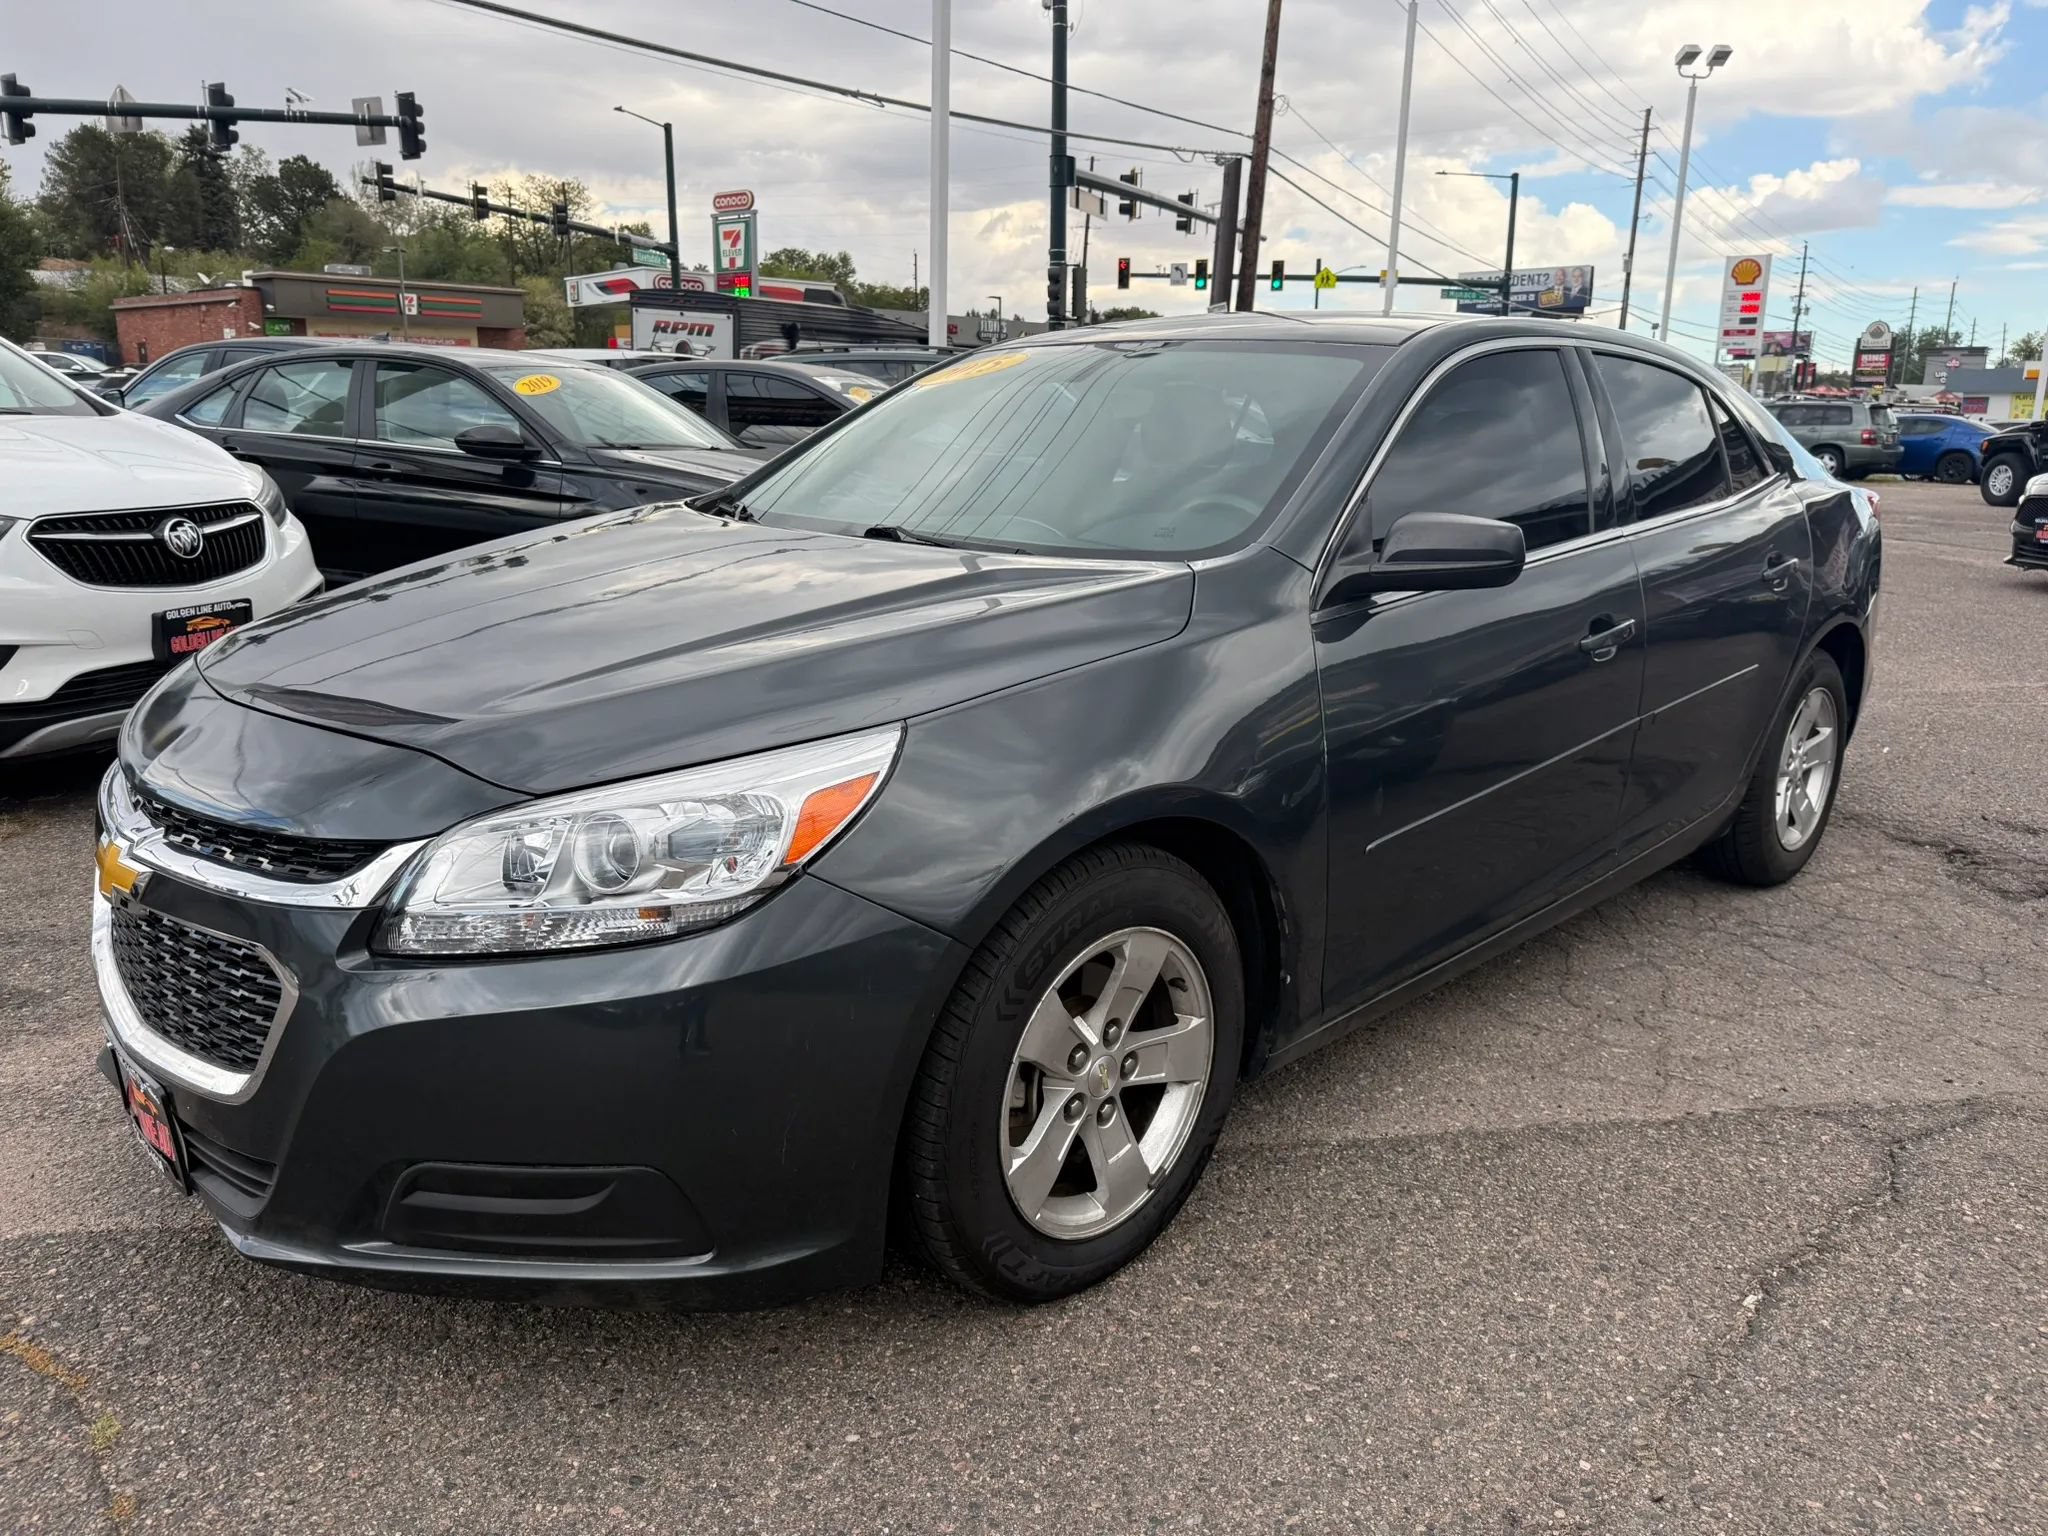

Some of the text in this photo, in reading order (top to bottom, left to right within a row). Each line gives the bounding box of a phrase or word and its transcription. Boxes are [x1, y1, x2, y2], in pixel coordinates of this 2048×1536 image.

[660, 279, 704, 290] cooco
[652, 320, 714, 337] RPM
[196, 604, 213, 615] LINE
